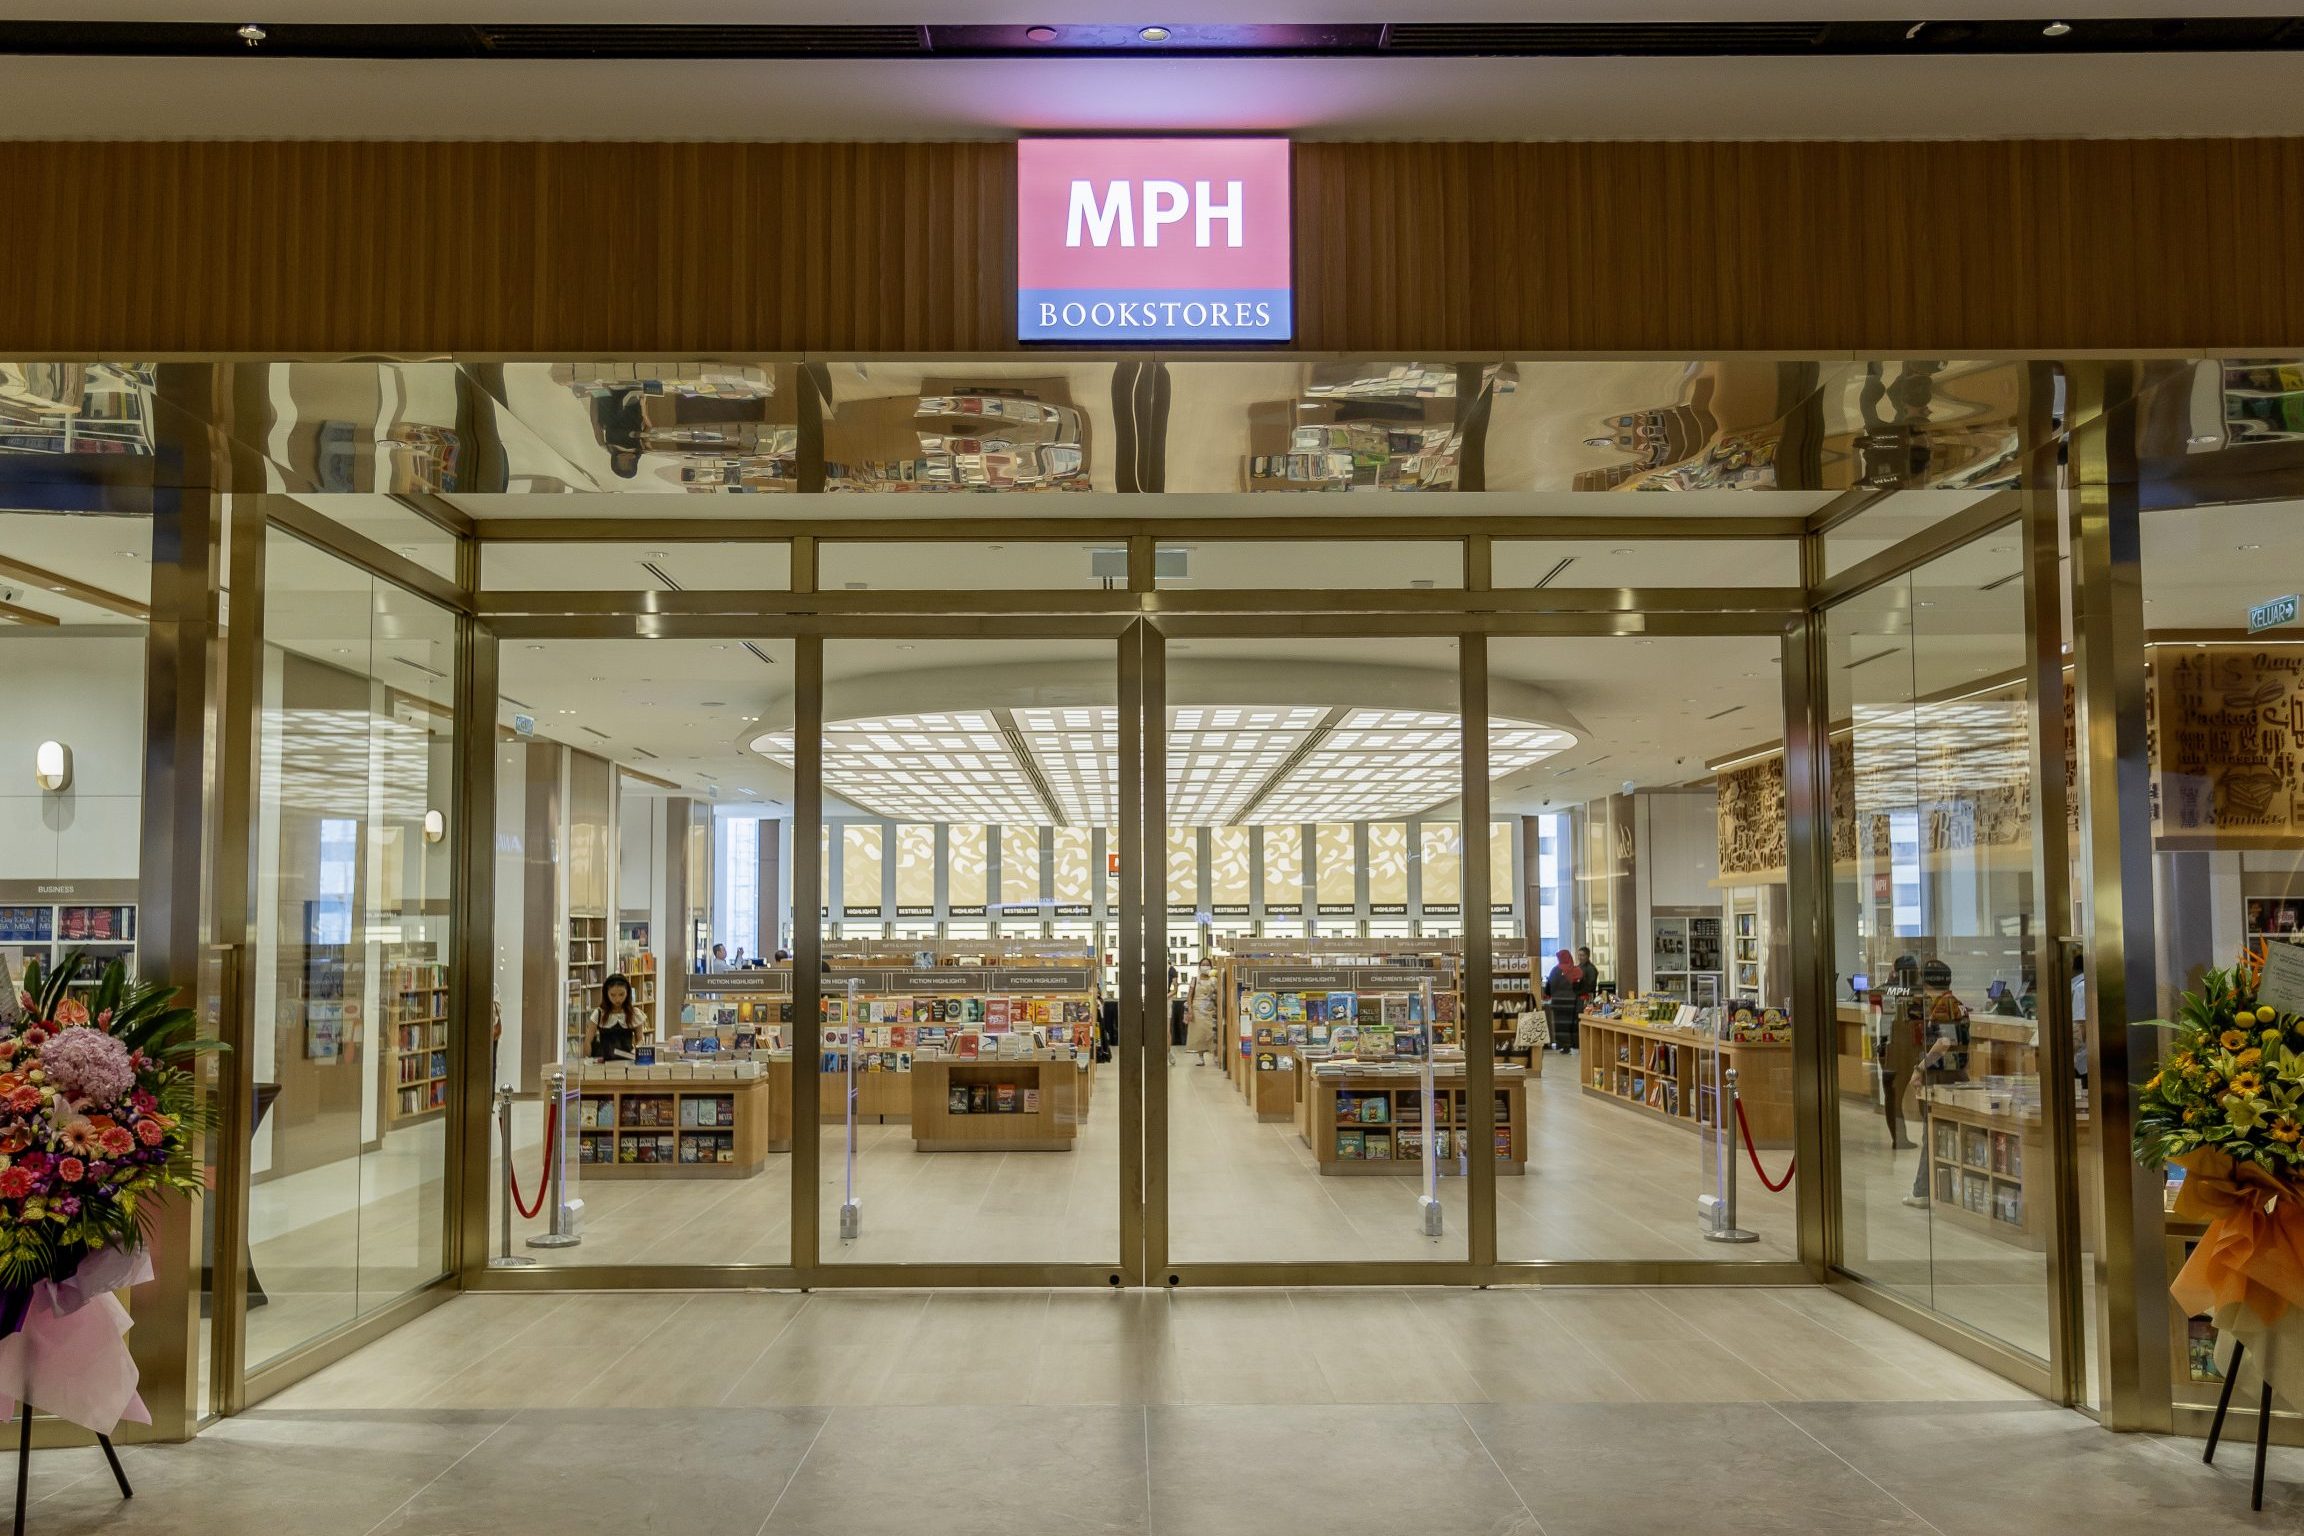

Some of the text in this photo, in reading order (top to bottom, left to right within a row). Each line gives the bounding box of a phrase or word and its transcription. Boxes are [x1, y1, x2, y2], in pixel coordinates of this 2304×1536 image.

[1066, 181, 1243, 248] MPH
[1039, 302, 1270, 328] BOOKSTORES
[2250, 604, 2285, 631] KELUAR
[37, 885, 75, 893] BUSINESS
[1887, 987, 1910, 996] MPH
